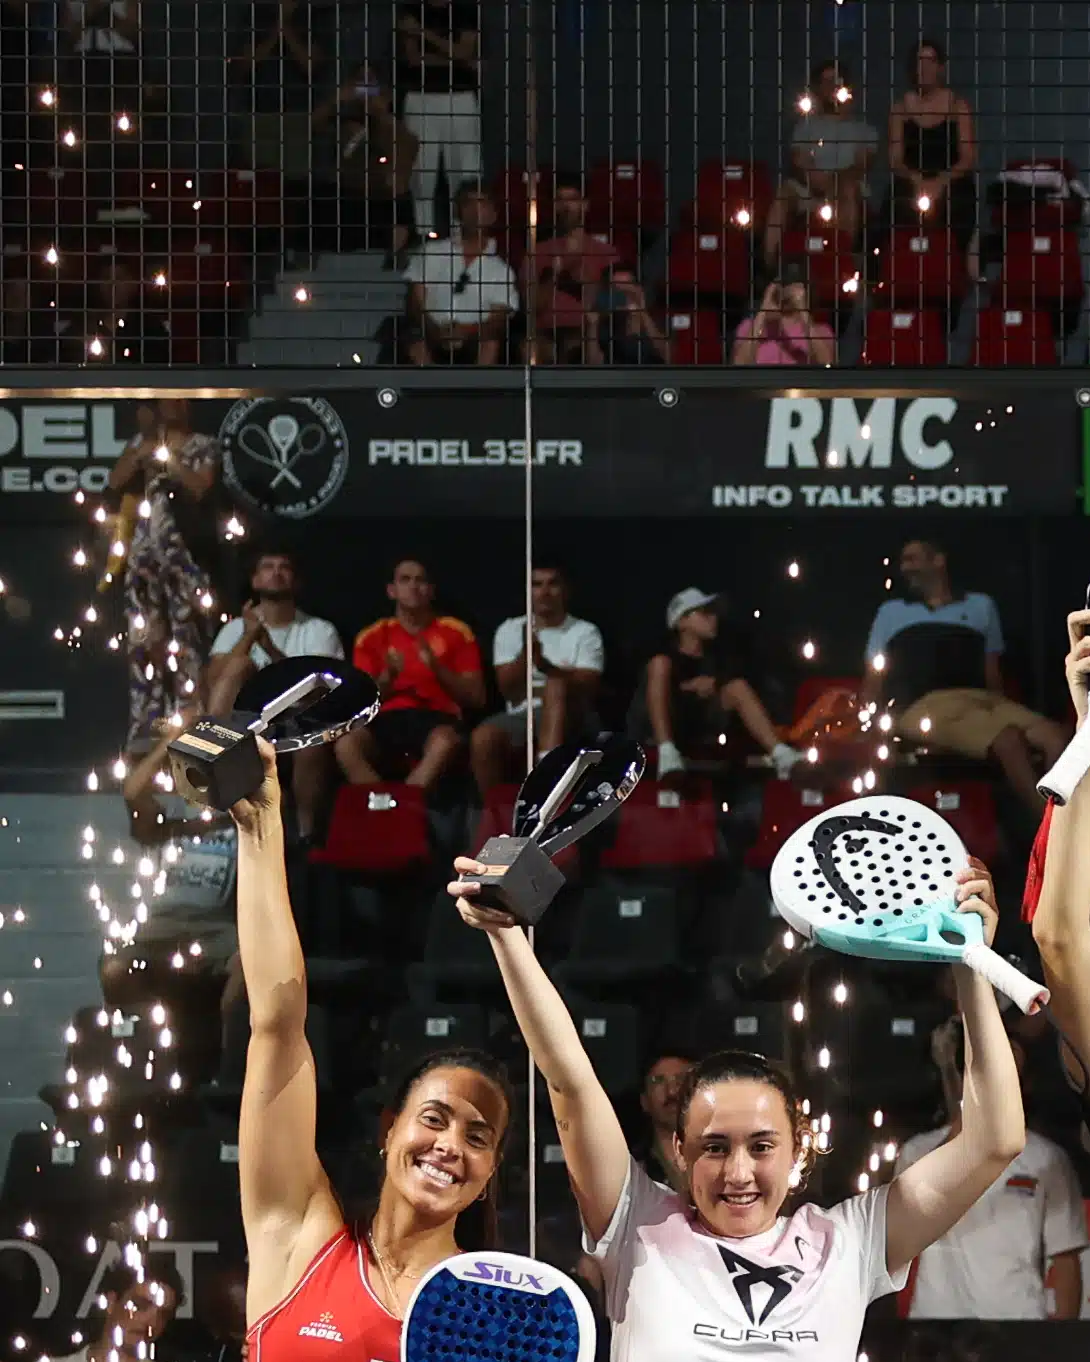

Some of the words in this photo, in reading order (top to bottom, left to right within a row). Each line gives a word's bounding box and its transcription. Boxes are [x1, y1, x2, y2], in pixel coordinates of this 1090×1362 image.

[765, 397, 957, 470] RMC
[368, 438, 583, 466] PADEL33.FR
[711, 485, 793, 508] INFO
[800, 485, 885, 508] TALK
[892, 485, 1008, 508] SPORT
[298, 1326, 344, 1343] PADEL
[692, 1322, 819, 1343] CUPRA
